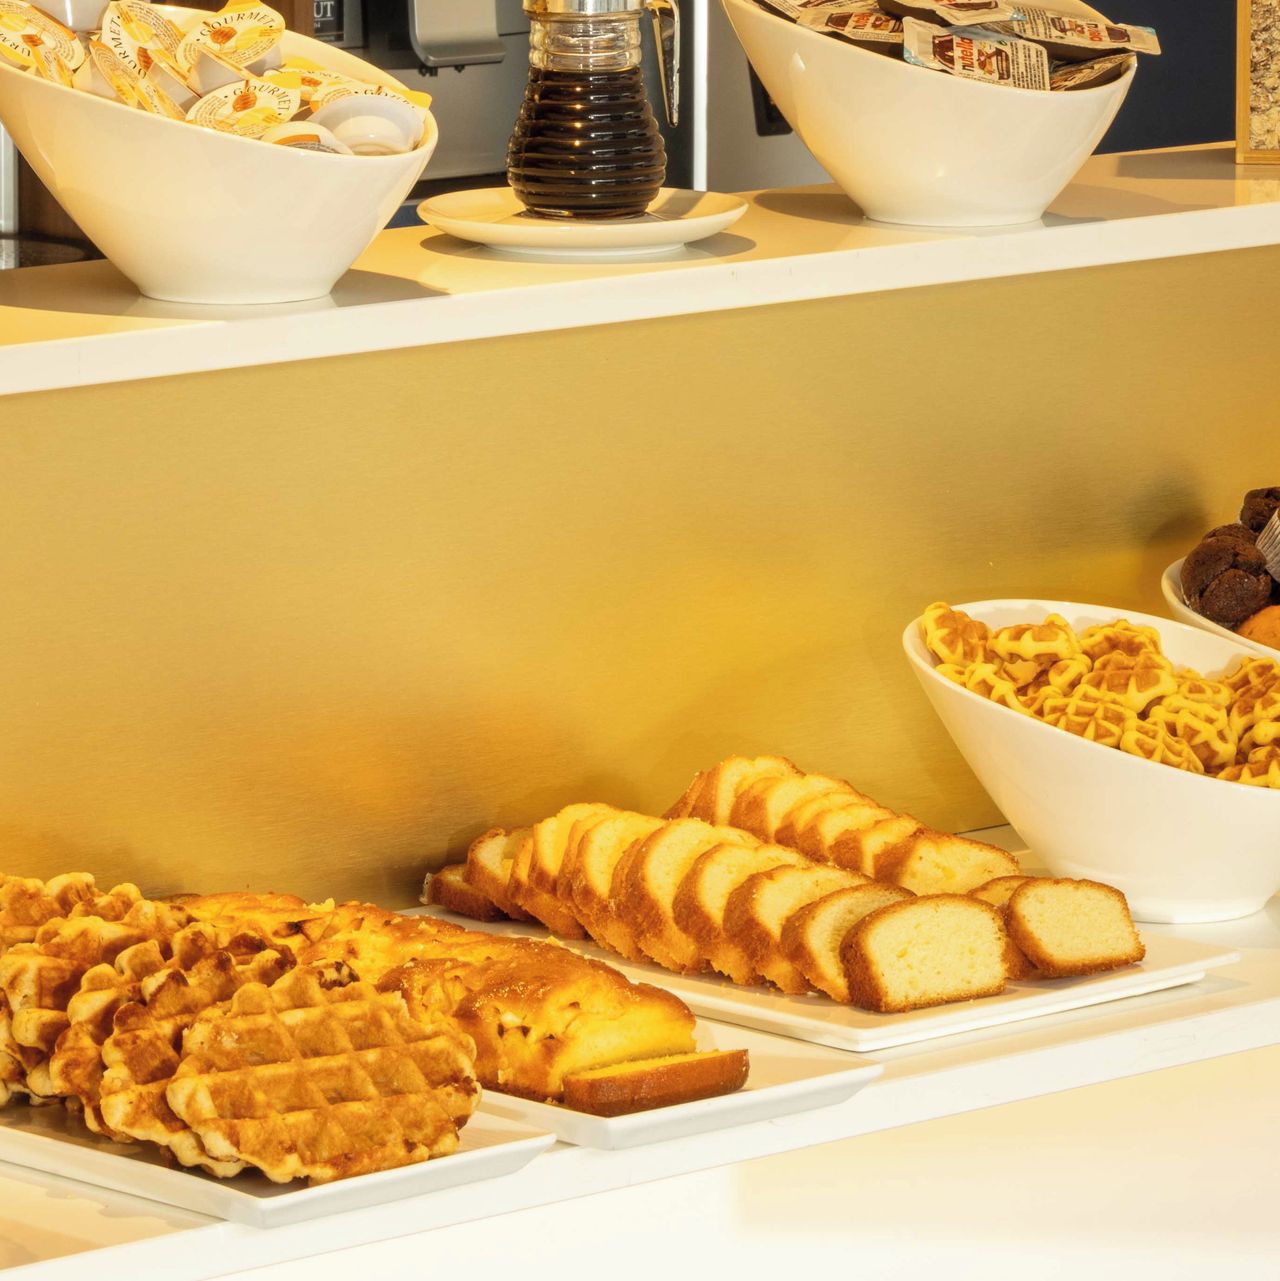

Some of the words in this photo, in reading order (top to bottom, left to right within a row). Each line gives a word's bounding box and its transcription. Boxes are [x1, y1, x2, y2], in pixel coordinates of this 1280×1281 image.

[313, 1, 335, 18] UT
[200, 11, 276, 37] GOURMET
[110, 17, 147, 79] OURMET
[955, 36, 975, 72] nutella
[233, 84, 291, 111] GOURMET
